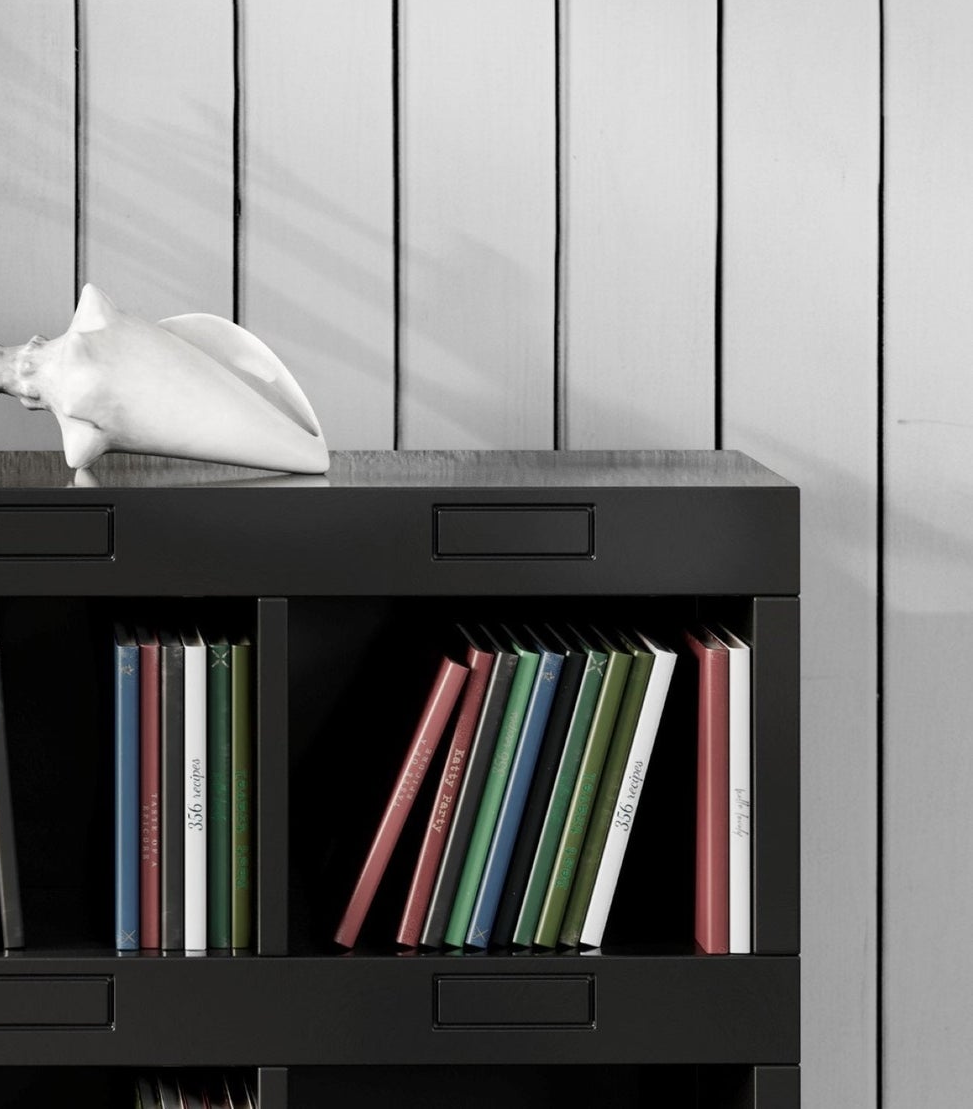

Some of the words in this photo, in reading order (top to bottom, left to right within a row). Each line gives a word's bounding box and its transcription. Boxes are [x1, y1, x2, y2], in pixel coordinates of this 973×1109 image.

[189, 758, 205, 800] recipes
[445, 749, 465, 788] Katty
[432, 794, 453, 833] Party
[615, 803, 634, 832] 356
[627, 760, 644, 799] recipes
[187, 803, 204, 832] 356
